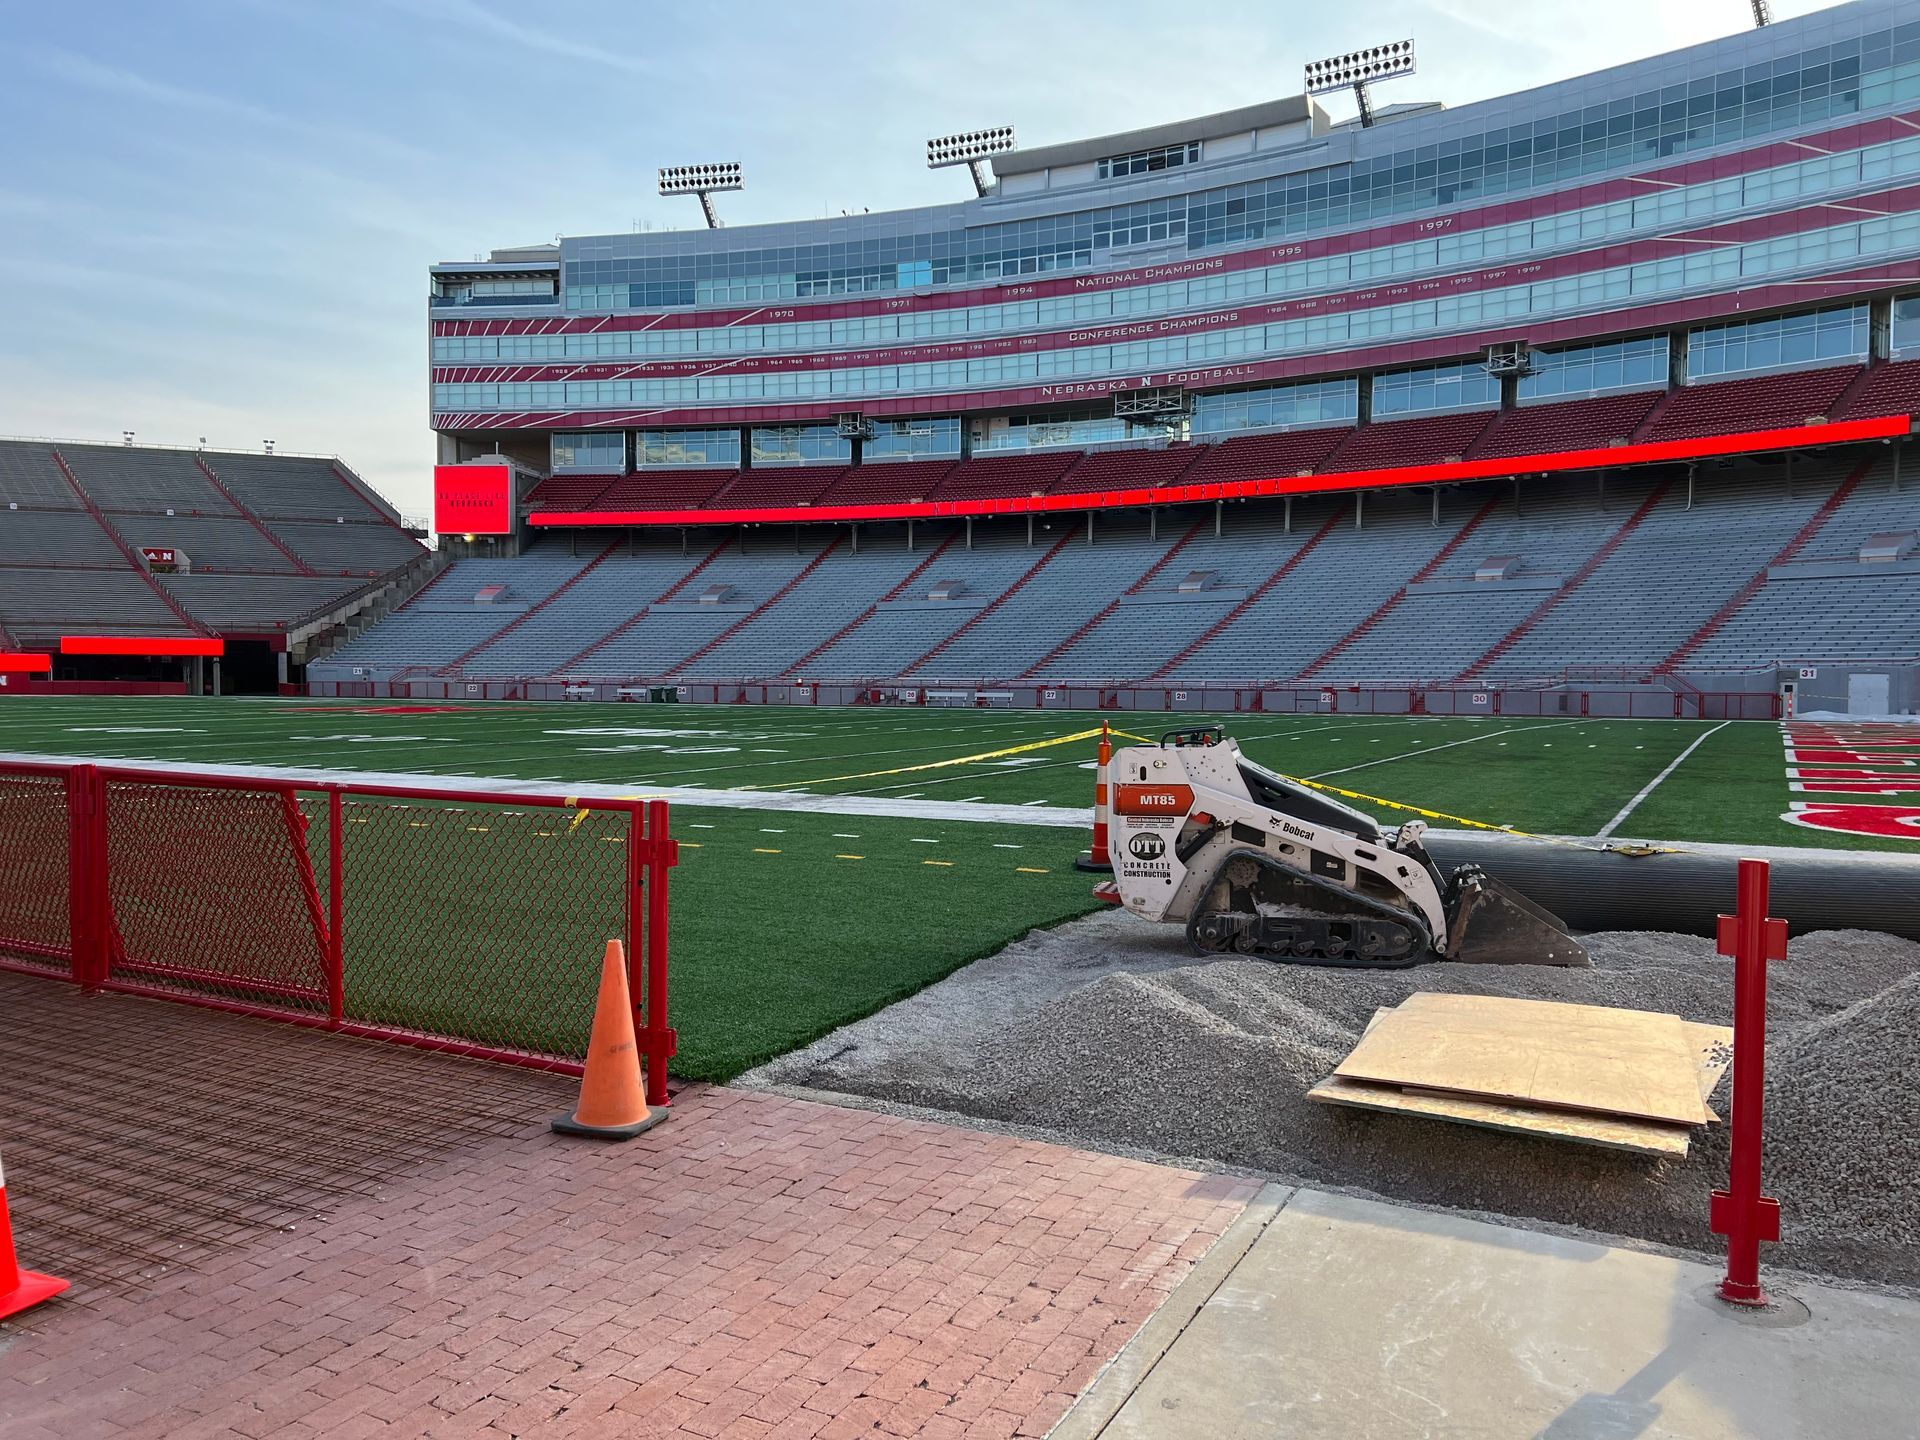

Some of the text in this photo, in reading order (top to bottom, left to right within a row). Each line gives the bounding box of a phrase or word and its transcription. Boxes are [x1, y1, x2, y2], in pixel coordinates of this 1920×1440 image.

[769, 219, 1453, 318] 1970 1971 1994 NATIONAL CHAMPIONS 1995 1997
[969, 343, 987, 351] 1981
[1069, 323, 1154, 342] CONFERENCE
[1159, 312, 1239, 331] CHAMPIONS
[1267, 305, 1288, 314] 1984
[1296, 301, 1317, 310] 1988
[1326, 297, 1346, 305] 1991
[1356, 292, 1377, 301] 1992
[1386, 287, 1409, 296] 1993
[1417, 282, 1441, 291] 1994
[1449, 276, 1473, 286] 1995
[1483, 271, 1507, 280] 1997
[1517, 265, 1541, 275] 1999
[1041, 365, 1255, 396] NEBRASKA N FOOTBALL
[162, 552, 172, 561] N
[1801, 669, 1815, 678] 31
[1473, 695, 1486, 703] 30
[1139, 795, 1176, 806] MT85
[1282, 821, 1315, 842] Bobcat
[1129, 839, 1164, 854] OTT
[1123, 862, 1171, 870] CONCRETE
[1123, 870, 1171, 879] CONSTRUCTION
